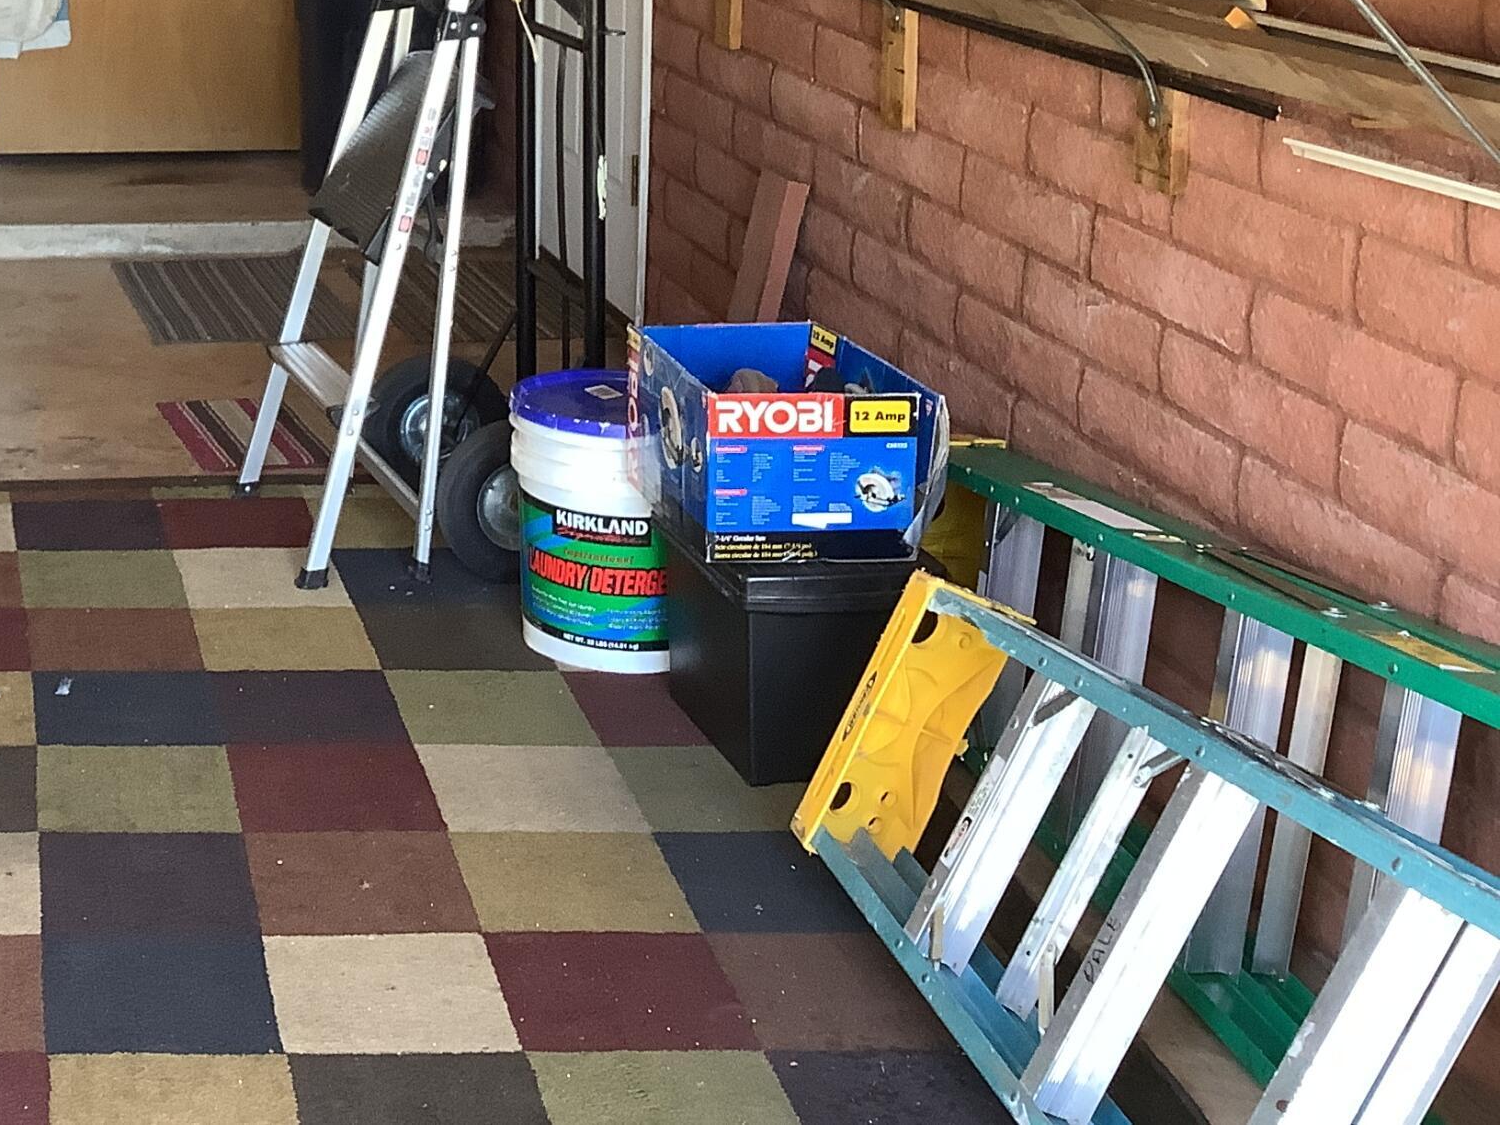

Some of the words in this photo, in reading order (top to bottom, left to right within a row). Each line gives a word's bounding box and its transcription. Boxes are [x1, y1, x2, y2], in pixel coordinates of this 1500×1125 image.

[715, 400, 834, 433] RYOBI
[855, 411, 869, 421] 12
[875, 411, 906, 423] Amp
[556, 509, 649, 536] KIRKLAND
[529, 546, 588, 591] LAUNDRY
[1084, 917, 1121, 984] DALE
